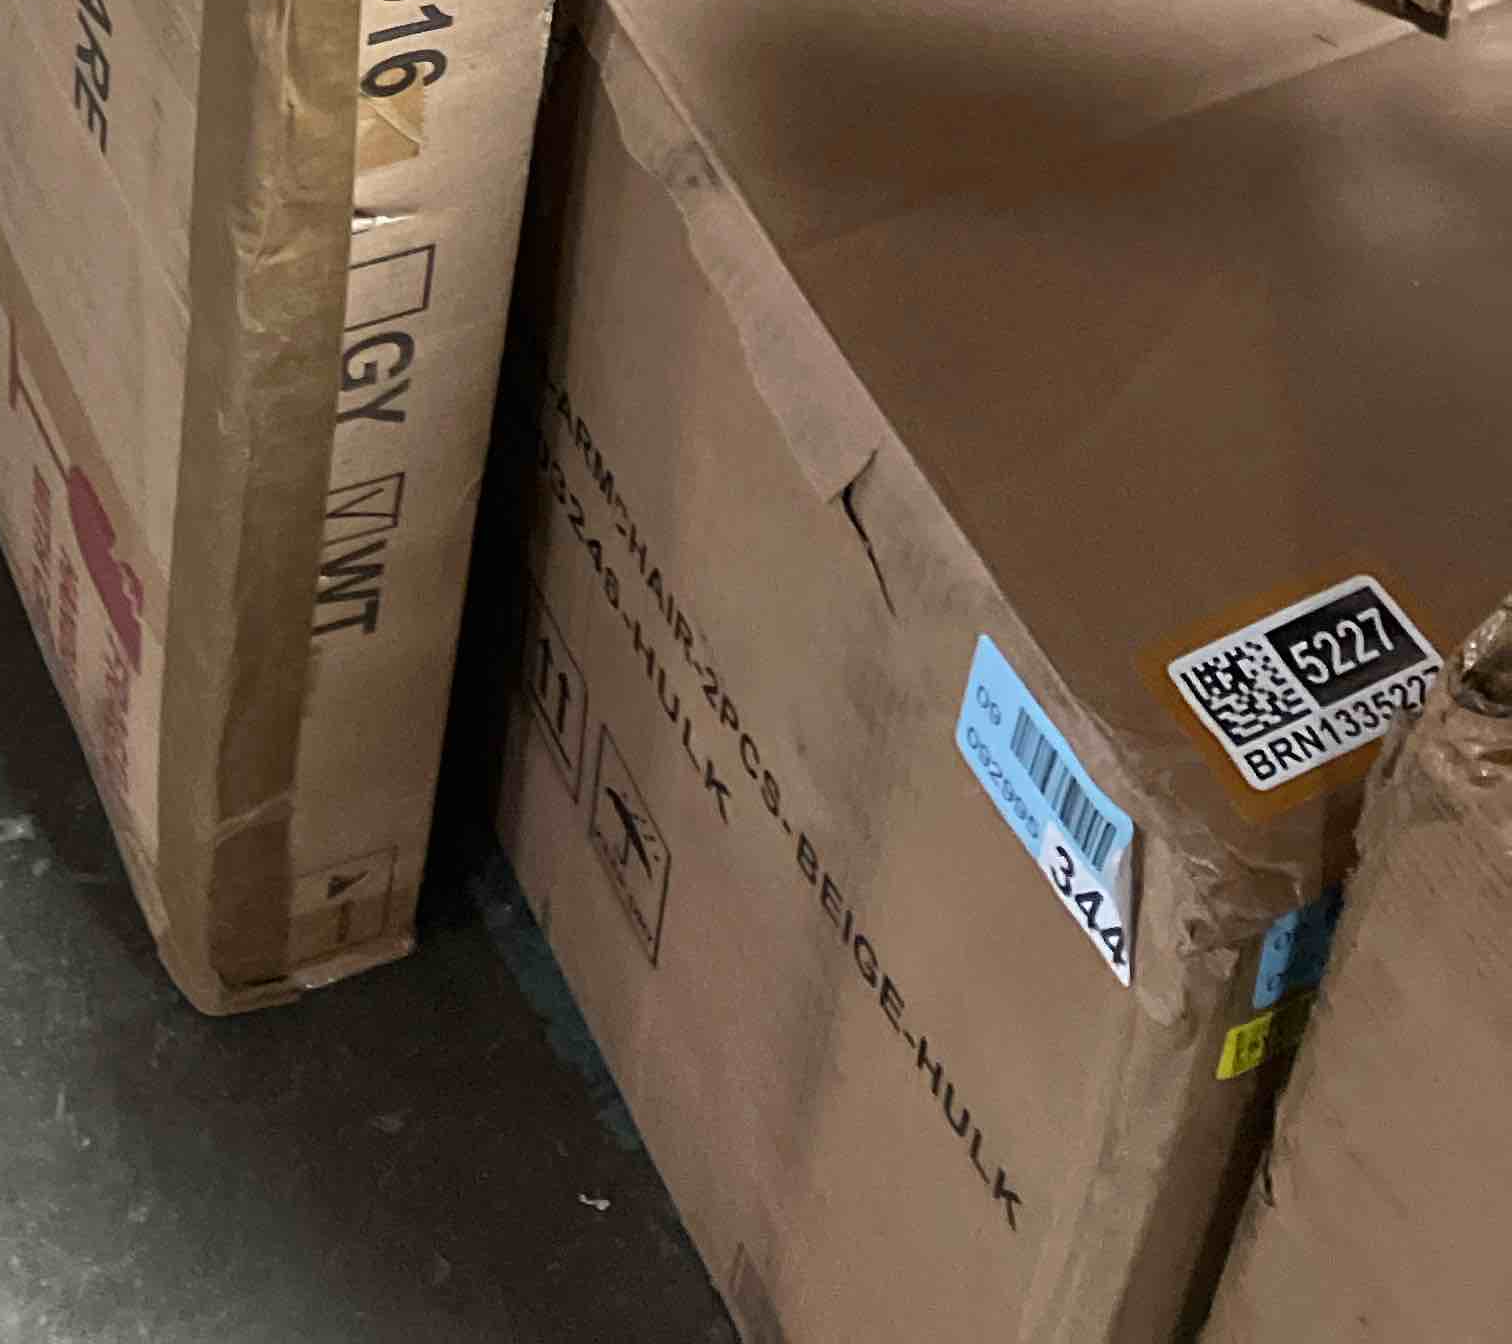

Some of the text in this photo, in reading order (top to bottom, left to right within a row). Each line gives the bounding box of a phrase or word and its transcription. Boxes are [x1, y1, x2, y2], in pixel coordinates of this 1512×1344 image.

[336, 330, 415, 425] GY
[1289, 607, 1395, 684] 5227
[1243, 666, 1440, 781] BRN133522
